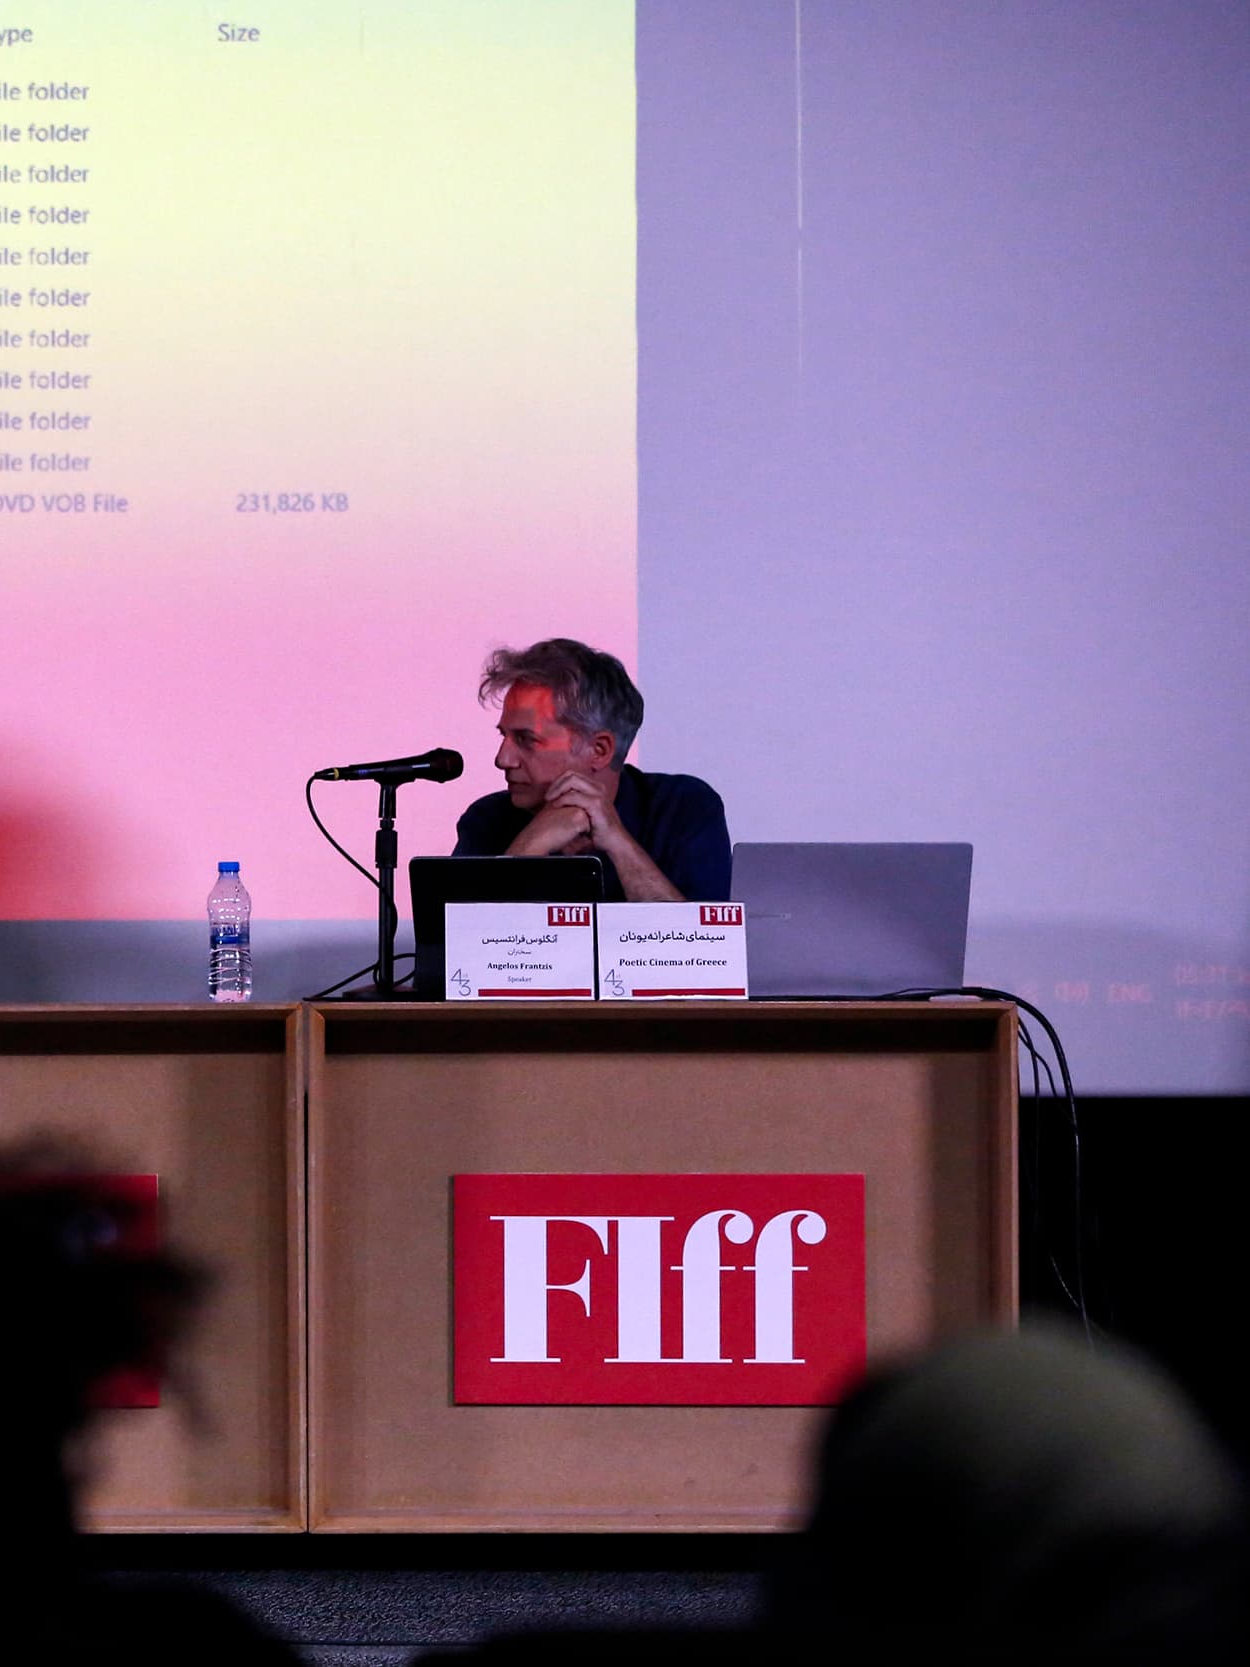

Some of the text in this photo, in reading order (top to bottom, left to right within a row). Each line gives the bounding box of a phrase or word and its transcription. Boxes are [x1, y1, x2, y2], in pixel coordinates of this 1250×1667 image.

[217, 23, 260, 42] Size
[27, 82, 89, 100] folder
[27, 123, 90, 142] folder
[28, 164, 89, 183] folder
[28, 206, 90, 224] folder
[29, 247, 90, 265] folder
[29, 288, 90, 307] folder
[29, 329, 90, 348] folder
[29, 371, 91, 389] folder
[29, 411, 91, 430] folder
[30, 453, 90, 472] folder
[41, 493, 86, 513] VOB
[93, 493, 128, 513] File
[236, 492, 349, 515] 231,826 KB
[619, 930, 726, 943] سینمای شاعرانه یونان
[487, 962, 553, 971] Angelos Frantzis
[619, 958, 727, 967] Poetic Cinema of Greece
